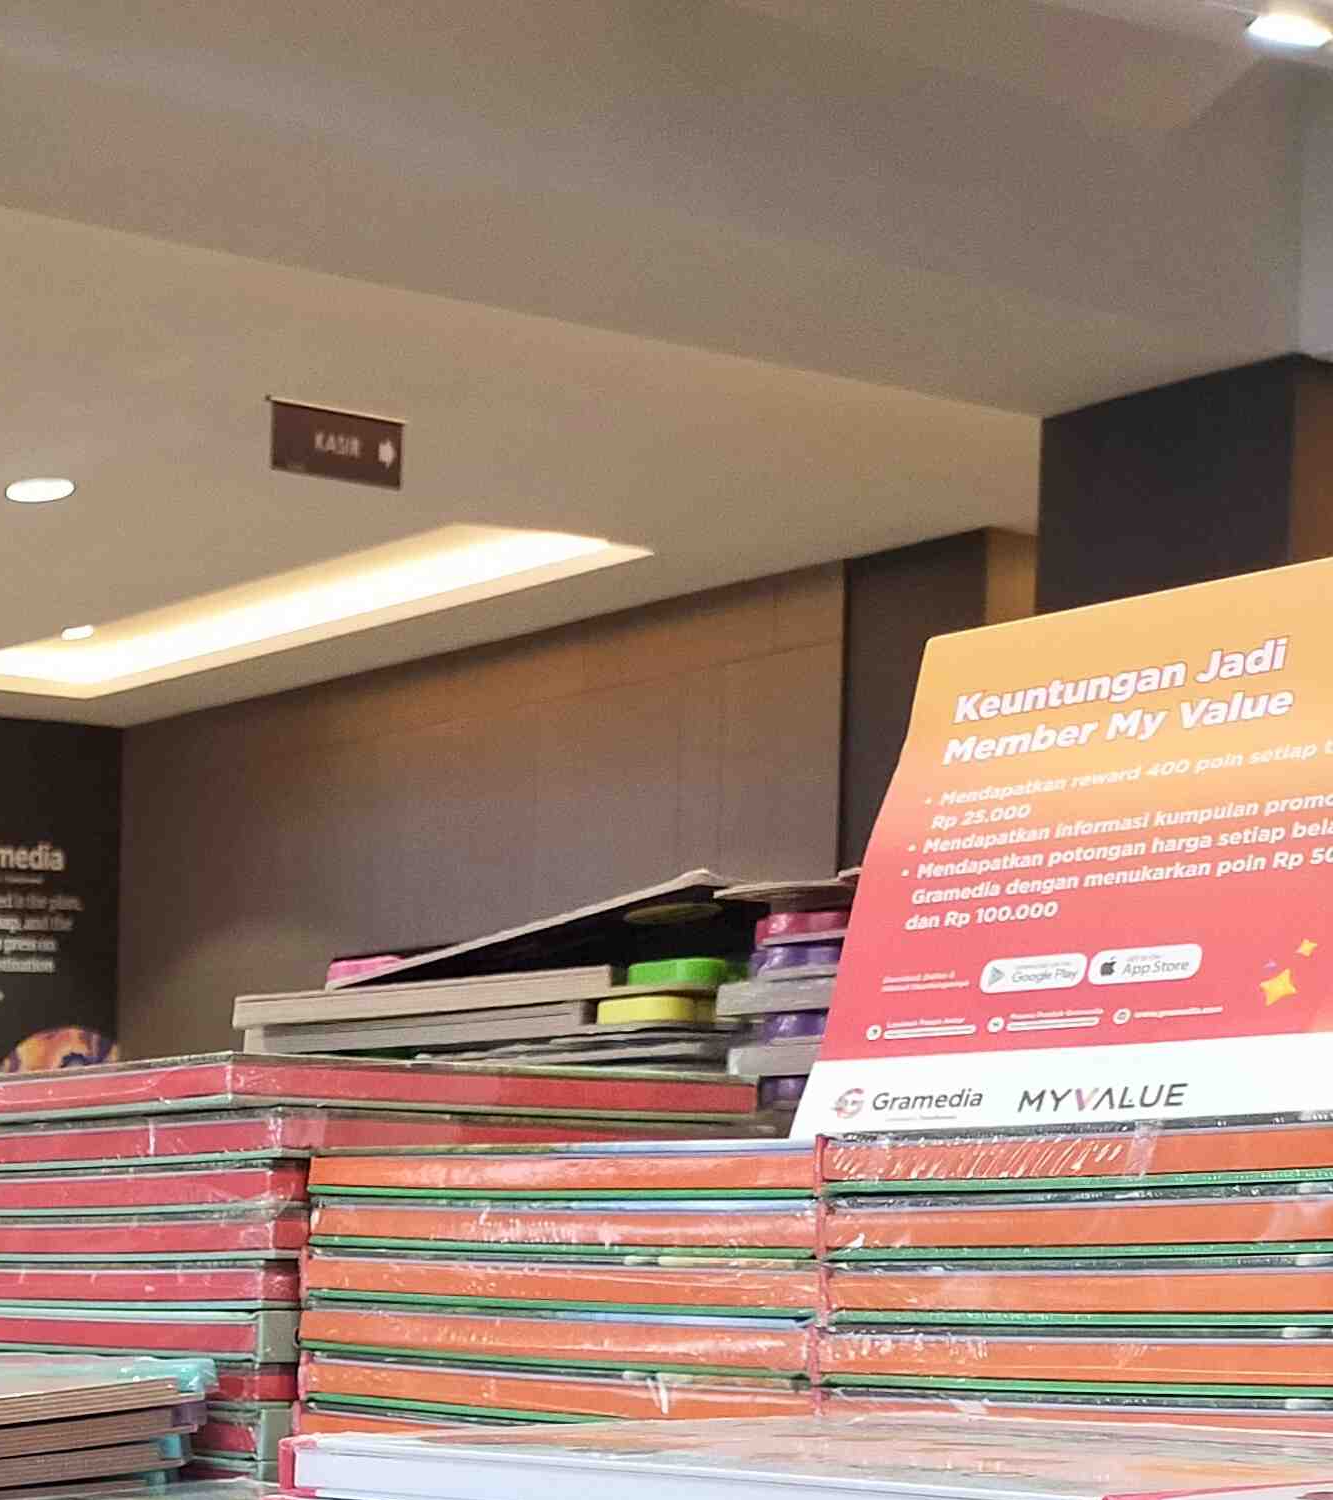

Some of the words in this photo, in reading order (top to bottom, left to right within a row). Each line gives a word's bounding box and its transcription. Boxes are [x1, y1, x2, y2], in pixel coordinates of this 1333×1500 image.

[952, 660, 1187, 724] Keuntungan
[1196, 637, 1289, 683] Jadi
[942, 718, 1097, 766] Member
[1105, 706, 1167, 742] My
[1179, 690, 1294, 731] Value
[939, 777, 1066, 807] Mendapatkan
[1195, 753, 1244, 774] poin
[1248, 743, 1318, 765] setiap
[922, 827, 1050, 855] Mendapatkan
[1155, 802, 1259, 828] kumpulan
[930, 814, 958, 831] Rp
[961, 803, 1031, 826] 25.000
[911, 881, 1001, 906] Gramedia
[1005, 873, 1079, 896] dengan
[1082, 861, 1211, 889] menukarkan
[1216, 854, 1267, 877] poin
[1271, 850, 1304, 871] Rp
[916, 851, 1044, 880] Mendapatkan
[1047, 841, 1146, 868] potongan
[1151, 834, 1213, 855] harga
[1217, 825, 1286, 847] setiap
[904, 912, 940, 931] dan
[943, 910, 971, 929] Rp
[974, 900, 1059, 924] 100.000
[1121, 961, 1151, 977] App
[1153, 957, 1190, 973] Store
[872, 1087, 984, 1112] Gramedia
